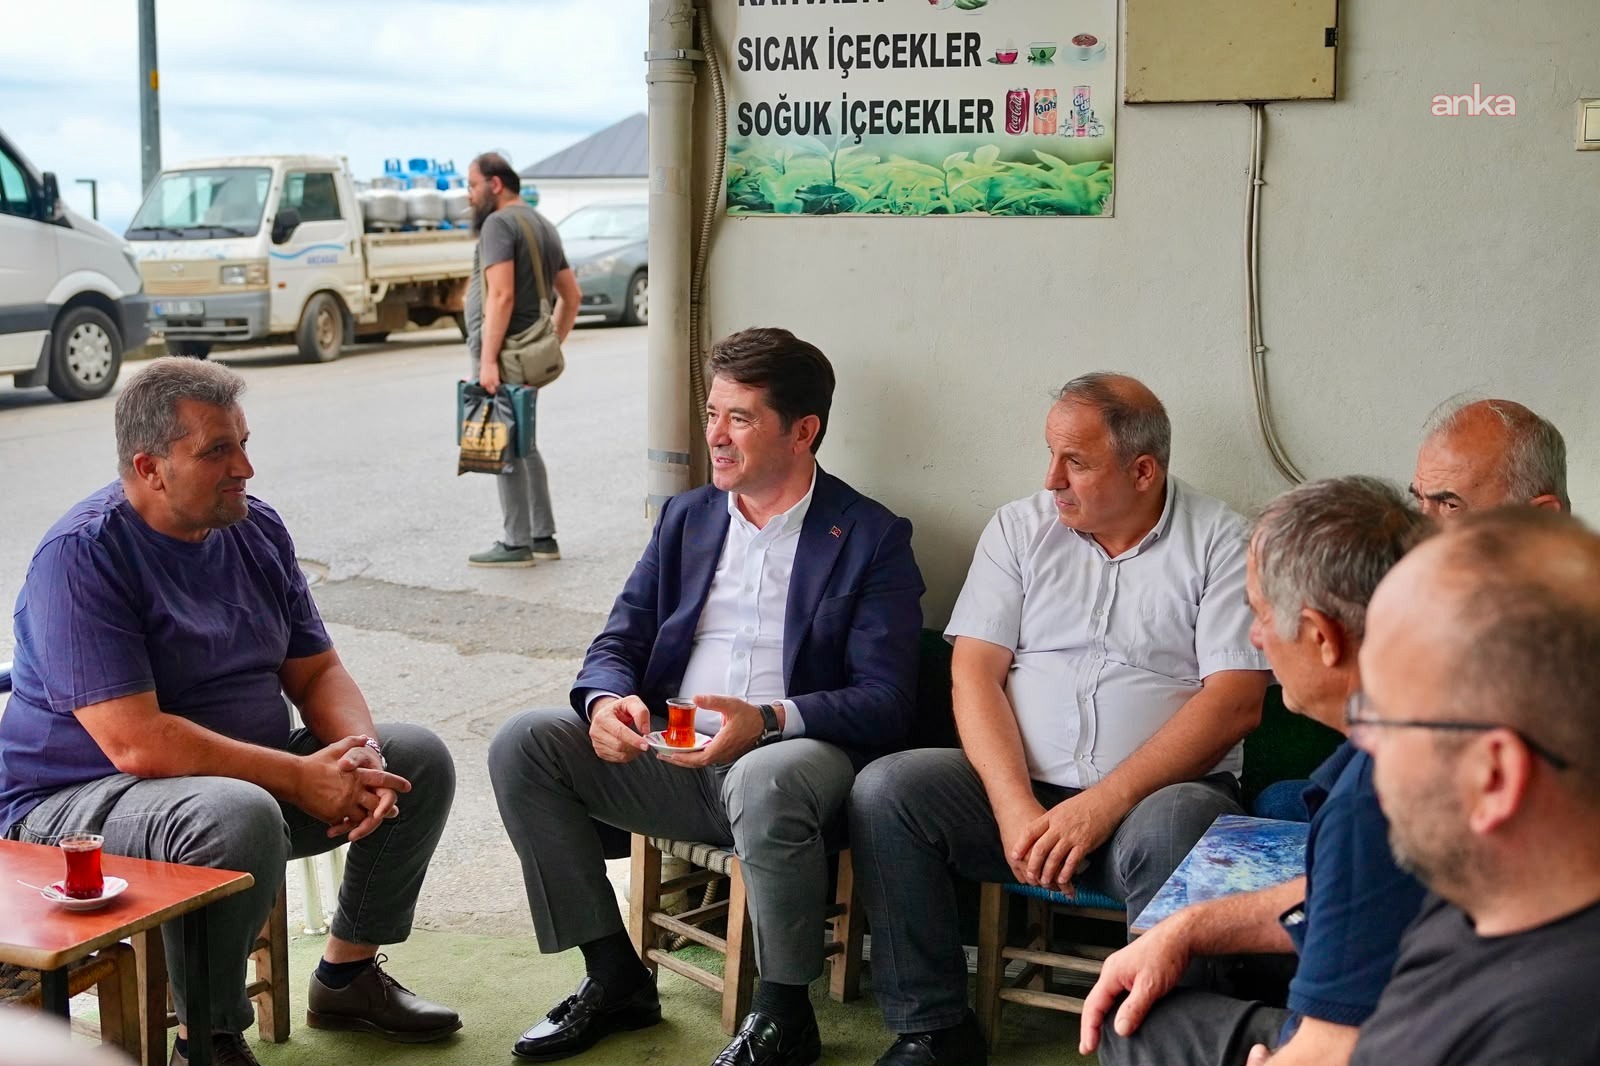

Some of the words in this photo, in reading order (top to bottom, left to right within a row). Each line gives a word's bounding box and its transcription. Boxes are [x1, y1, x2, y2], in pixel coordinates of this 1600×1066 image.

[738, 35, 819, 72] SICAK
[828, 27, 982, 78] İÇECEKLER
[738, 93, 832, 136] SOĞUK
[841, 92, 994, 144] İÇECEKLER
